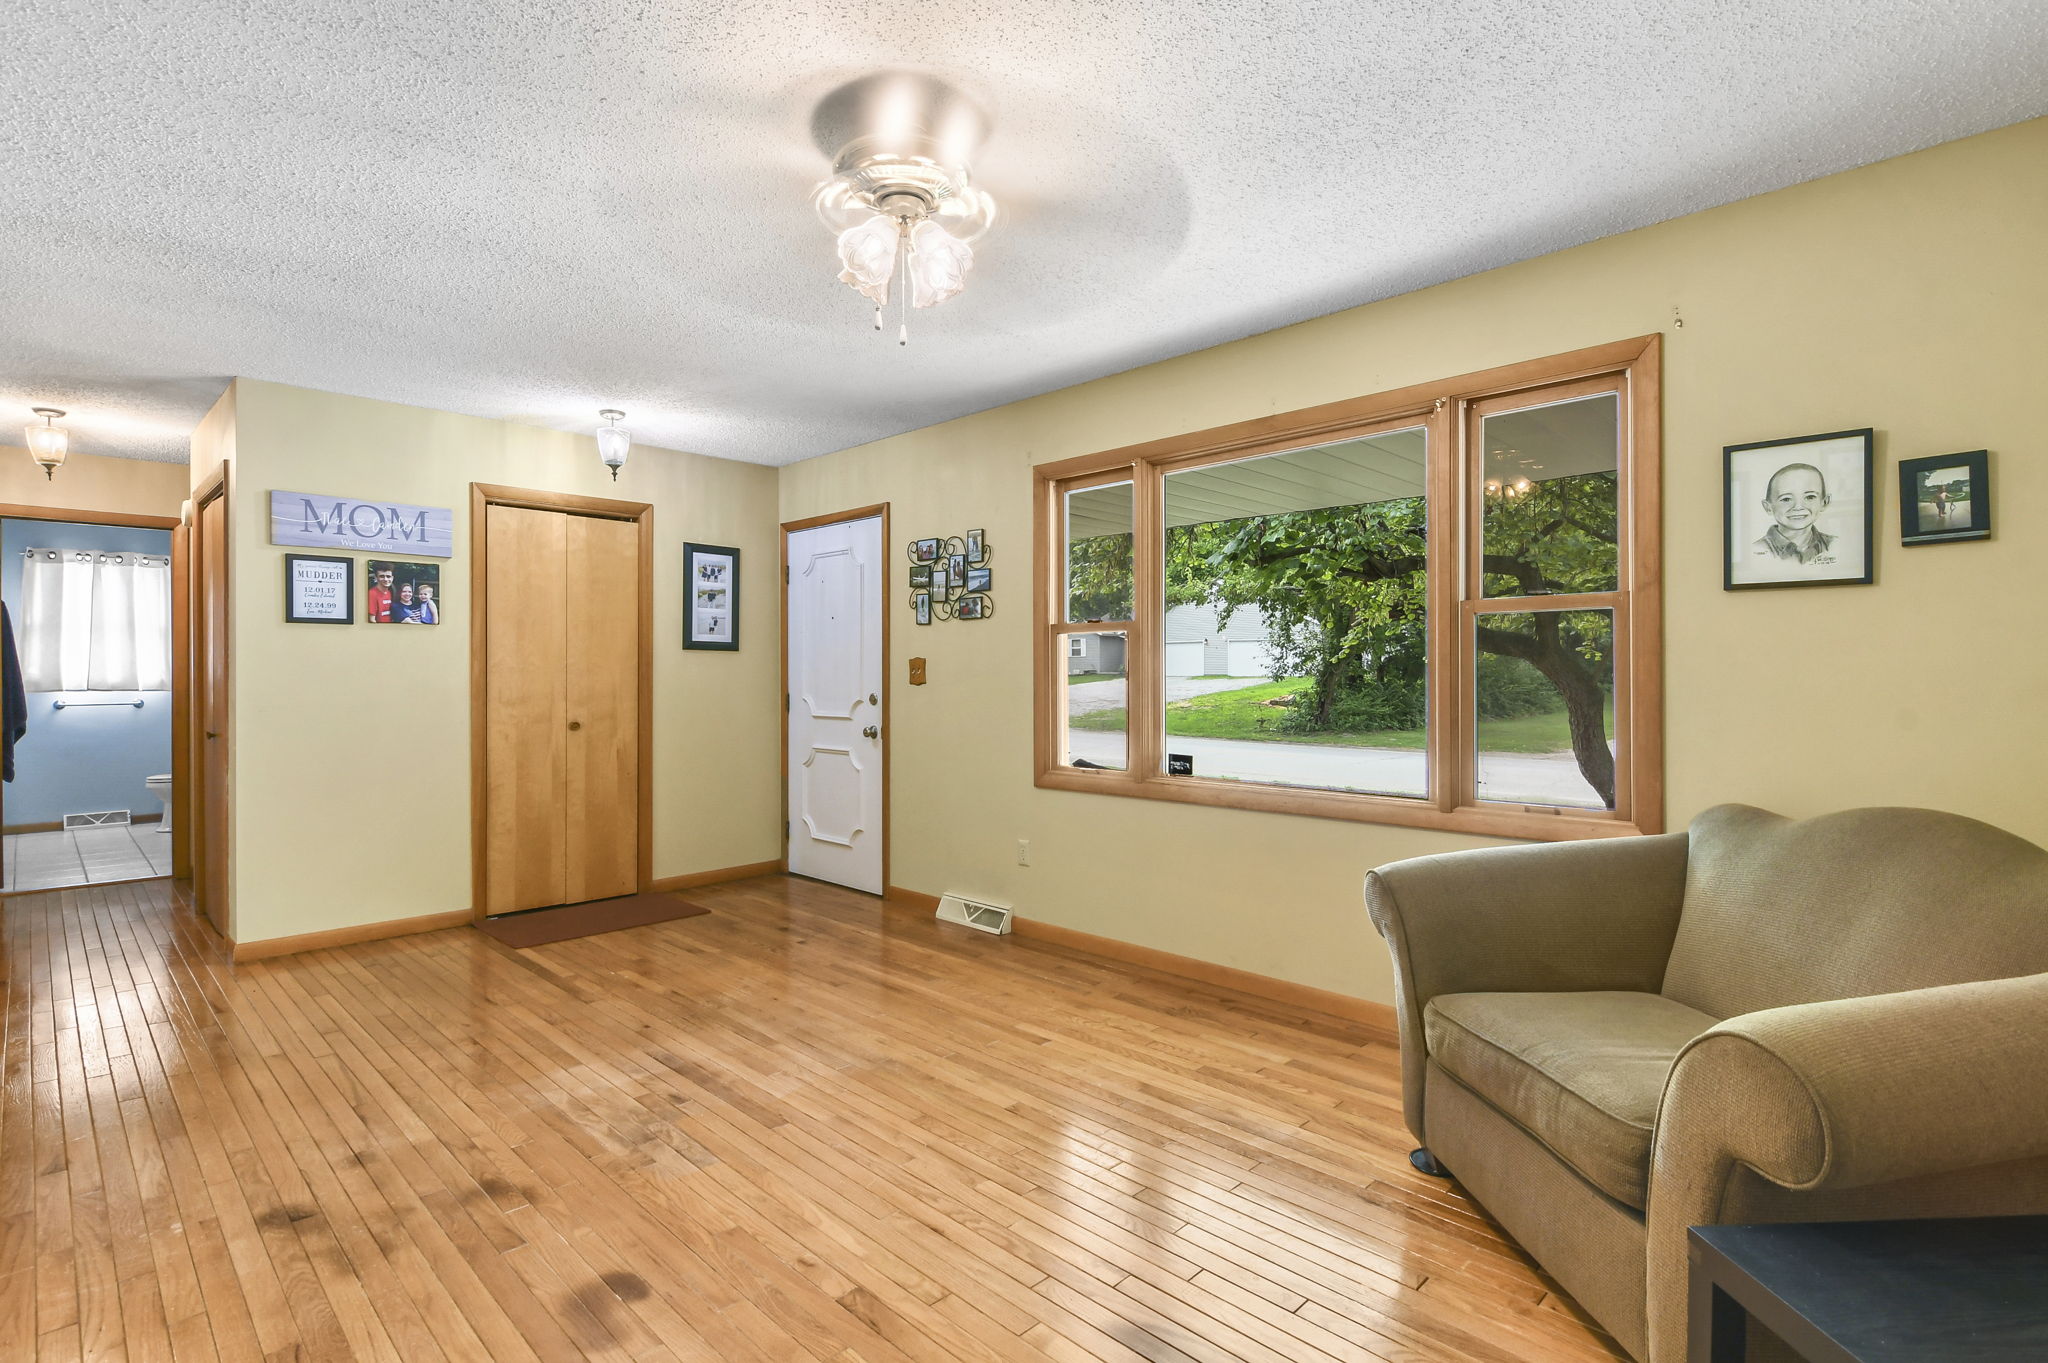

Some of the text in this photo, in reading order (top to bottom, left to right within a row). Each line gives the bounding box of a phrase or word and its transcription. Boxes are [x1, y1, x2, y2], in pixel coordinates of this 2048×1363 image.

[300, 498, 429, 543] MOM
[341, 539, 393, 550] We Love You
[297, 570, 343, 580] MUDDER
